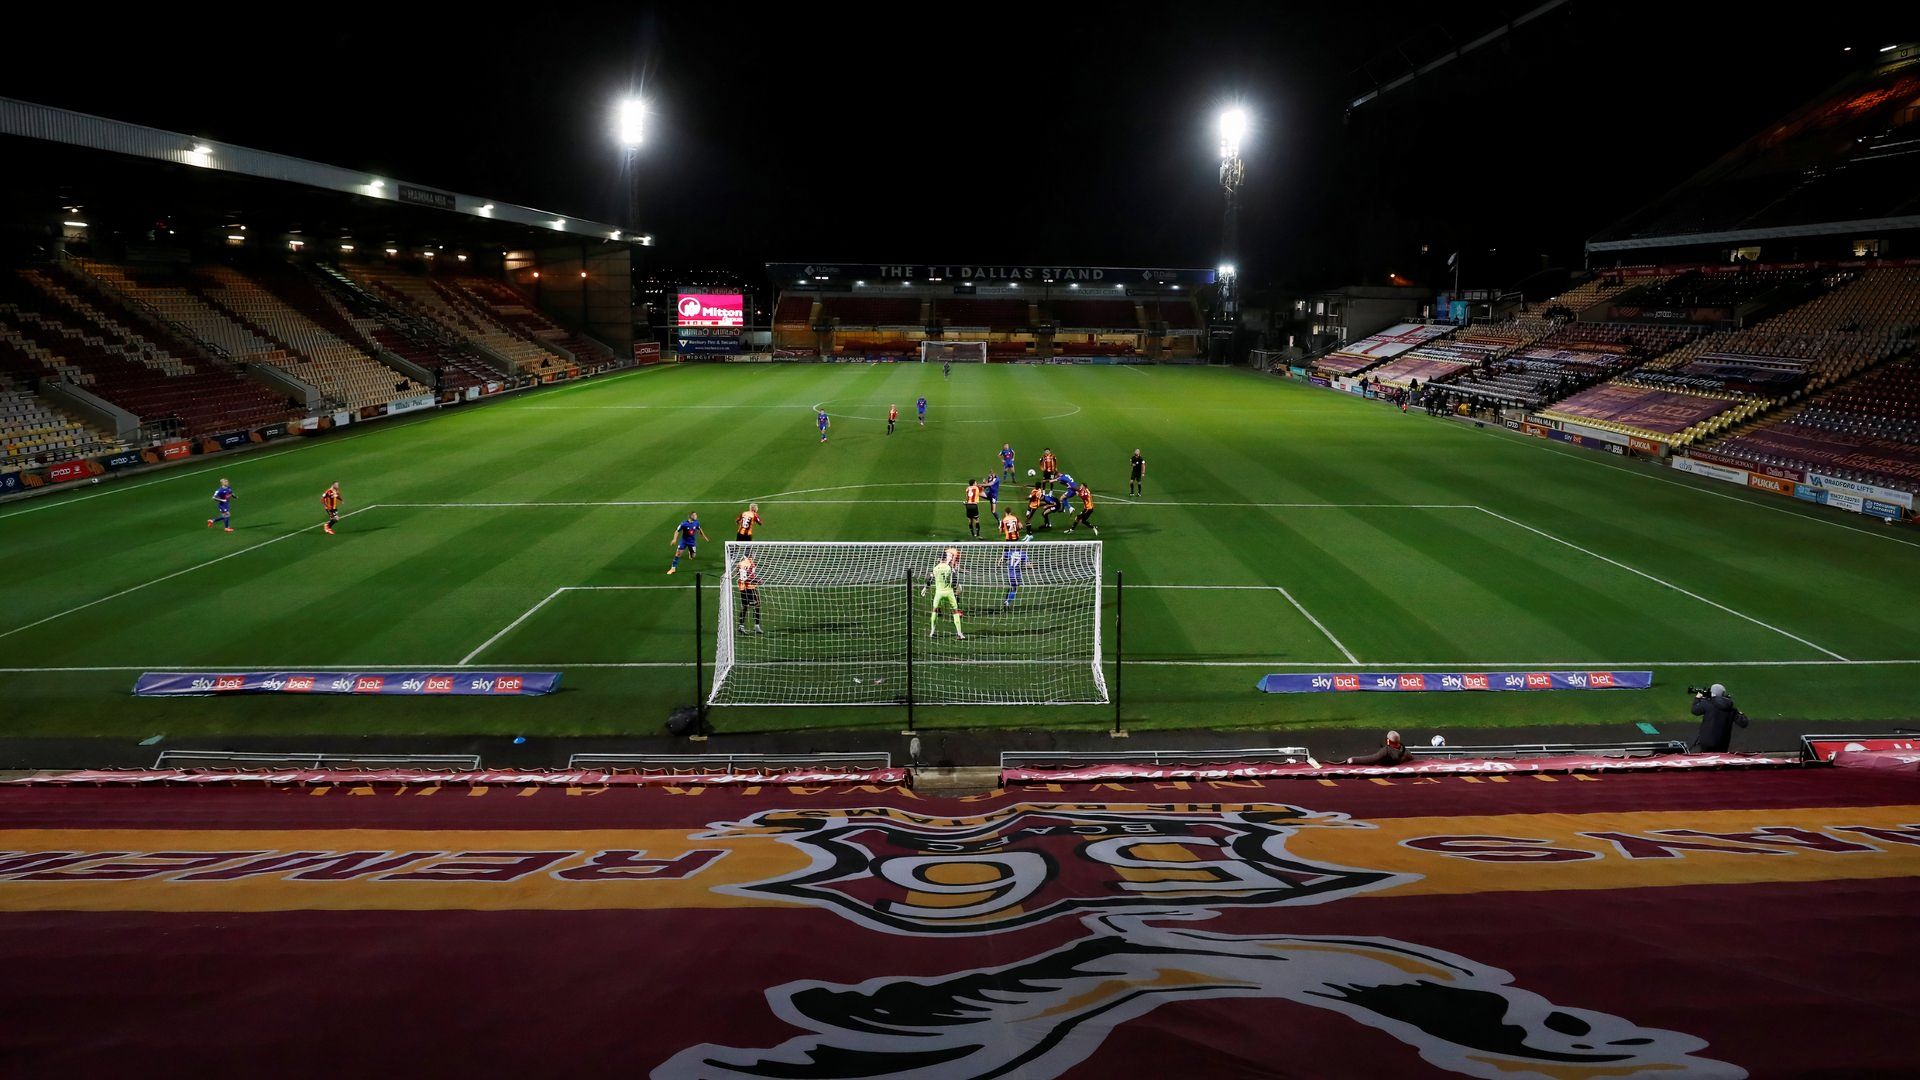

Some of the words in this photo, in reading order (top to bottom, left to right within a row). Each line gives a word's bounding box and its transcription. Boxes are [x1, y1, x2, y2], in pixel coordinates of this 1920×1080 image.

[880, 266, 913, 278] THE
[961, 267, 1033, 279] DALLAS
[1042, 268, 1104, 280] STAND
[1752, 476, 1780, 491] PUKKA
[1824, 478, 1856, 490] BRADFORD
[191, 677, 215, 690] sky
[218, 677, 242, 689] bet
[261, 677, 286, 690] sky
[288, 678, 312, 689] bet
[331, 678, 355, 691] sky
[358, 678, 382, 689] bet
[401, 678, 425, 691] sky
[428, 678, 451, 689] bet
[471, 678, 494, 691] sky
[497, 678, 520, 689] bet
[1312, 676, 1332, 690] sky
[1336, 676, 1356, 687] bet
[1377, 676, 1397, 689] sky
[1401, 676, 1422, 687] bet
[1442, 675, 1461, 689] sky
[1465, 675, 1486, 687] bet
[1505, 675, 1524, 688] sky
[1528, 675, 1549, 685] bet
[1568, 674, 1587, 687] sky
[1590, 674, 1611, 684] bet
[870, 835, 1295, 919] 56
